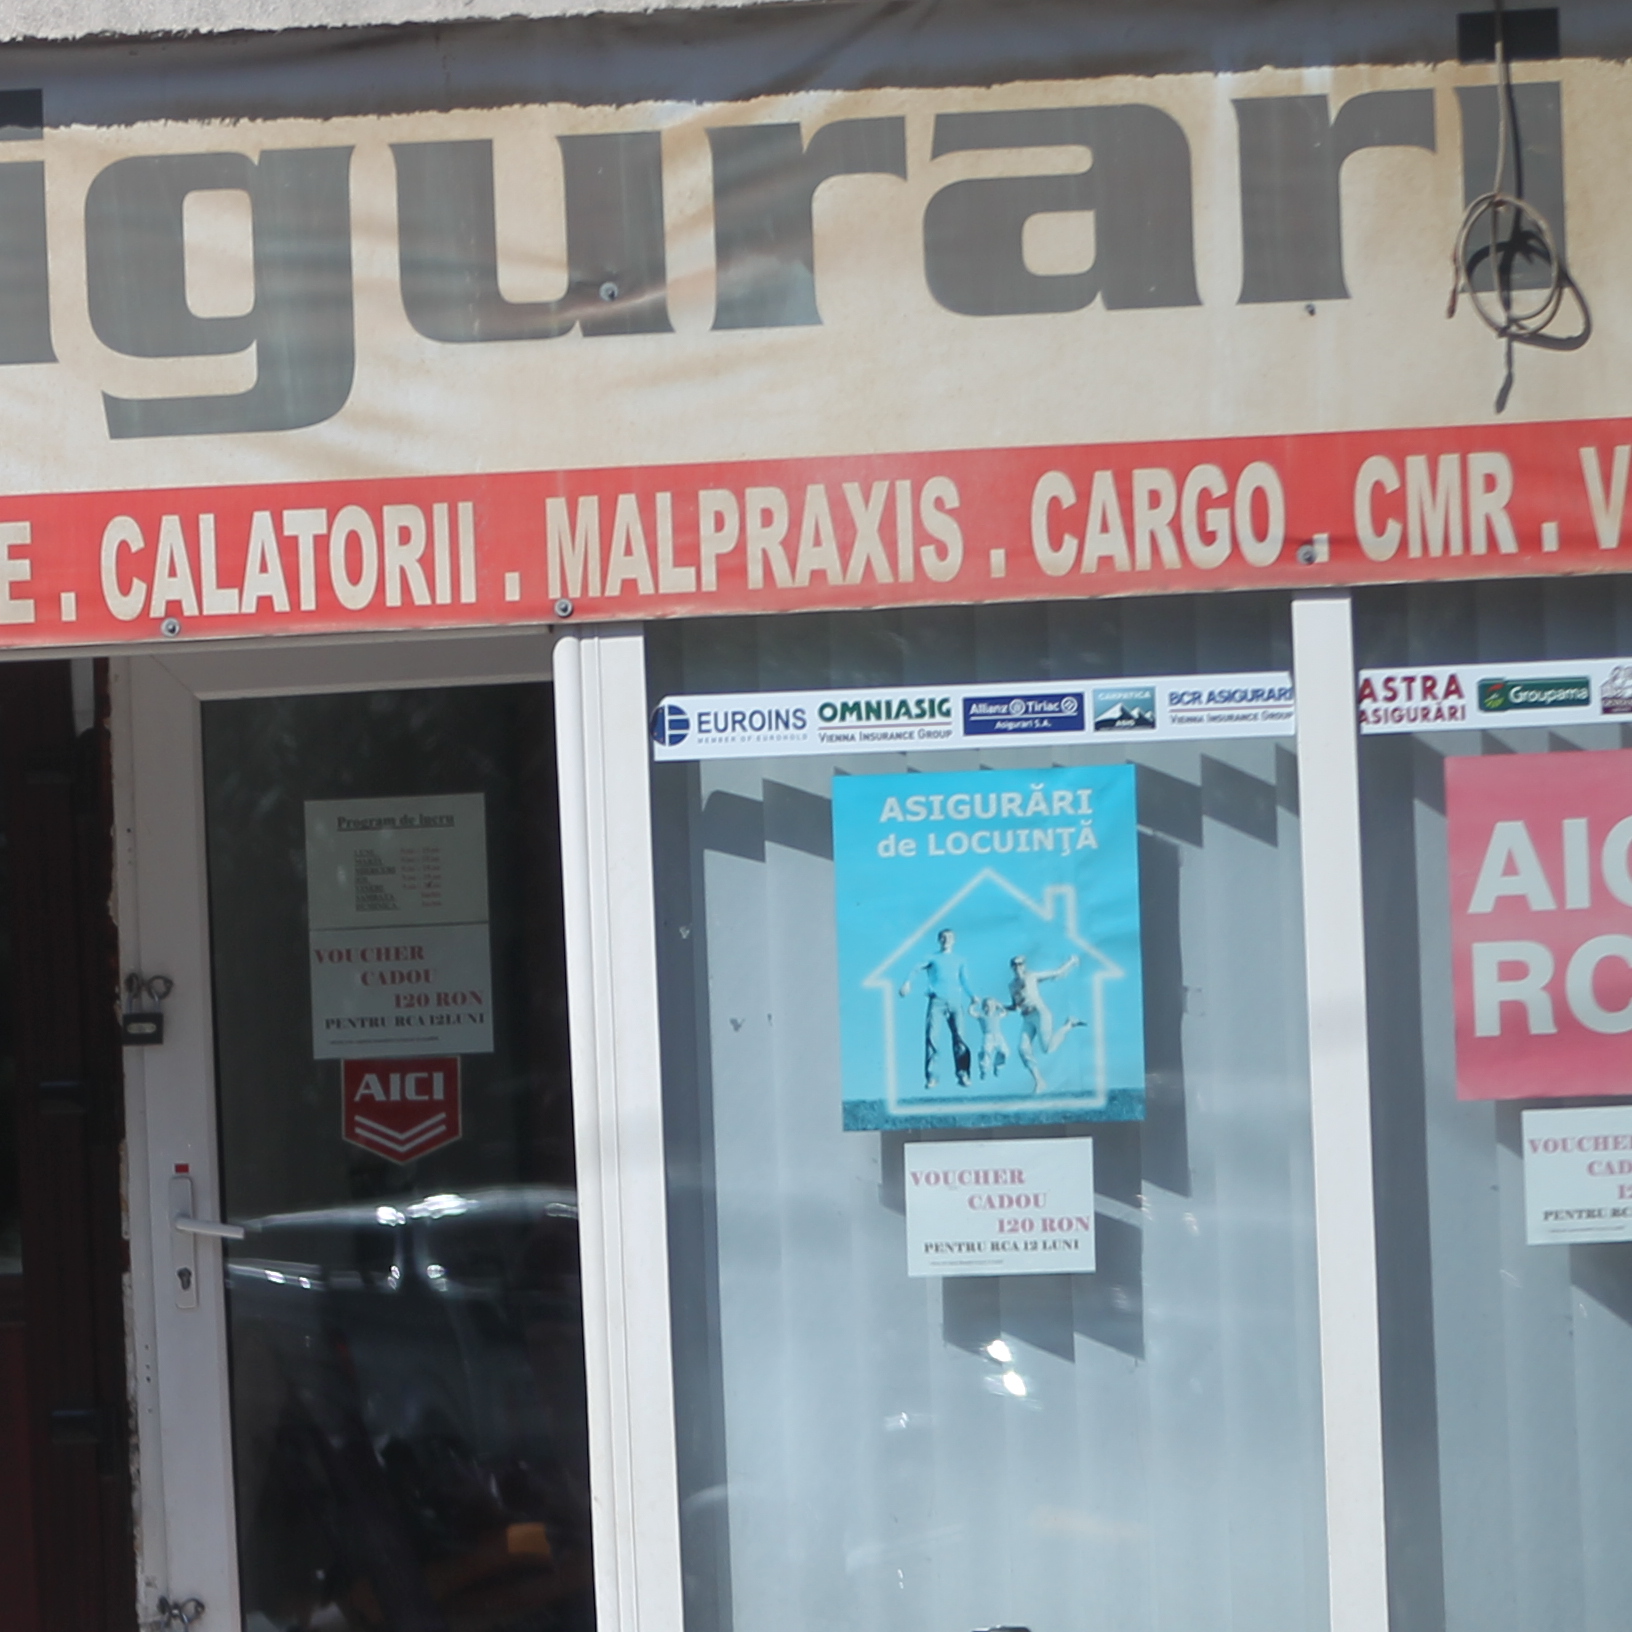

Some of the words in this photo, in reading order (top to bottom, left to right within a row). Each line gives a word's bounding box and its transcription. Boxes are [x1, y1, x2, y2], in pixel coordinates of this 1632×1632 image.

[101, 500, 477, 621] CALATORII
[546, 475, 964, 598] MALPRAXIS
[1031, 461, 1285, 577] CARGO
[1354, 451, 1519, 562] CMR
[1169, 690, 1203, 706] BCR
[1358, 674, 1466, 704] ASTRA
[1509, 684, 1590, 706] Groupama
[817, 697, 953, 723] OMNIASIG
[969, 701, 1009, 716] Allianz
[697, 708, 807, 733] EUROINS
[879, 782, 1094, 823] ASIGURĂRI
[877, 832, 917, 858] de
[314, 945, 426, 964] VOUCHER
[360, 968, 436, 987] CADOU
[393, 991, 431, 1009] 120
[435, 989, 485, 1008] RON
[325, 1015, 391, 1030] PENTRU
[394, 1014, 427, 1028] RCA
[353, 1071, 445, 1103] AICI
[1529, 1134, 1632, 1154] VOUCHE
[910, 1168, 1025, 1187] VOUCHER
[967, 1192, 1047, 1211] CADOU
[997, 1217, 1035, 1234] 120
[1040, 1216, 1091, 1233] RON
[924, 1240, 986, 1255] PENTRU
[990, 1239, 1020, 1253] RCA
[1042, 1238, 1080, 1251] LUNI
